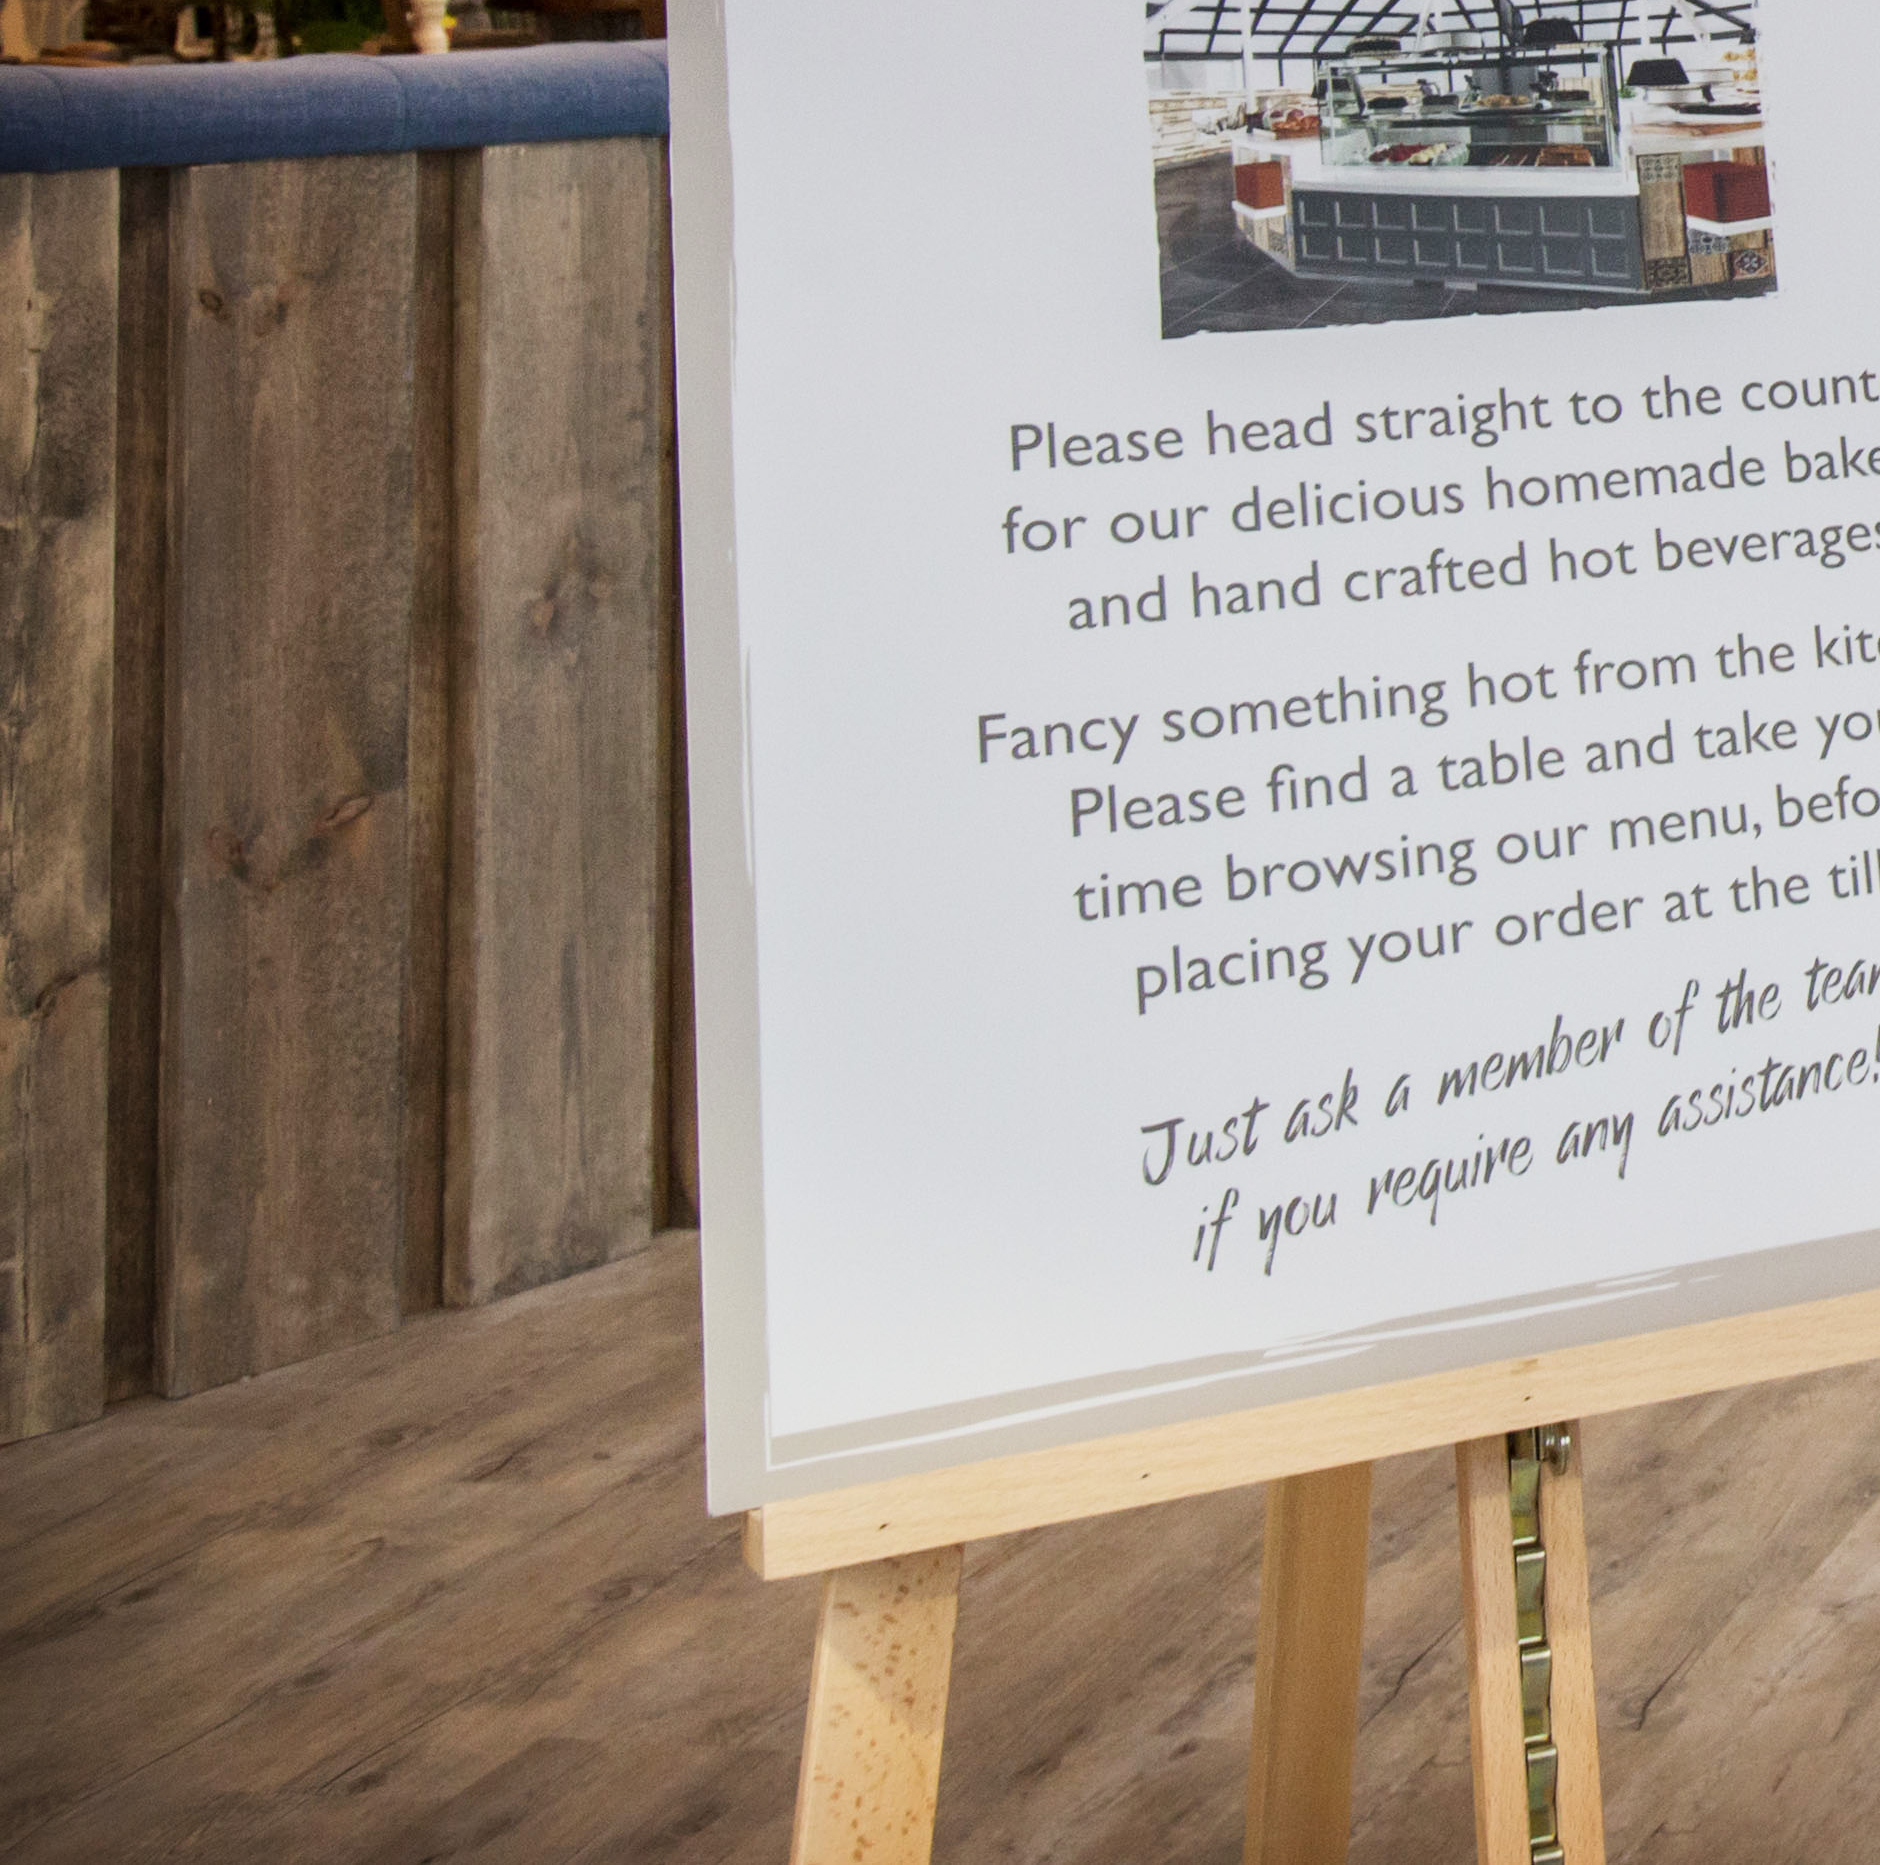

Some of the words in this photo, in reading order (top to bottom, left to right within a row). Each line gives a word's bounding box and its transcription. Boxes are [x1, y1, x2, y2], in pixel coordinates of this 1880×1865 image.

[1012, 423, 1182, 470] Please
[1208, 401, 1331, 454] head
[1357, 388, 1551, 447] straight
[1570, 392, 1622, 425] to
[1642, 375, 1721, 419] the
[1002, 506, 1086, 553] for
[1111, 506, 1208, 543] our
[1233, 480, 1463, 531] delicious
[1487, 446, 1765, 509] homemade
[1070, 576, 1166, 629] and
[1193, 561, 1319, 617] hand
[1345, 541, 1526, 601] crafted
[1550, 538, 1636, 581] hot
[979, 714, 1138, 764] Fancy
[1164, 677, 1448, 741] something
[1469, 663, 1556, 706] hot
[1575, 650, 1695, 694] from
[1716, 634, 1794, 678] the
[1072, 785, 1244, 836] Please
[1267, 756, 1367, 811] find
[1392, 766, 1417, 796] a
[1438, 737, 1564, 790] table
[1587, 720, 1673, 772] and
[1695, 711, 1796, 758] take
[1074, 874, 1201, 920] time
[1227, 836, 1476, 900] browsing
[1498, 825, 1587, 863] our
[1611, 804, 1761, 849] menu,
[1137, 938, 1328, 1014] placing
[1348, 921, 1472, 983] your
[1496, 891, 1643, 945] order
[1665, 885, 1712, 922] at
[1730, 866, 1809, 912] the
[1142, 1098, 1269, 1185] Just
[1285, 1068, 1357, 1142] ask
[1386, 1075, 1409, 1116] a
[1438, 1015, 1624, 1105] member
[1649, 980, 1699, 1055] of
[1716, 969, 1780, 1033] the
[1194, 1189, 1238, 1271] if
[1260, 1194, 1336, 1275] you
[1368, 1138, 1532, 1225] require
[1557, 1113, 1633, 1179] any
